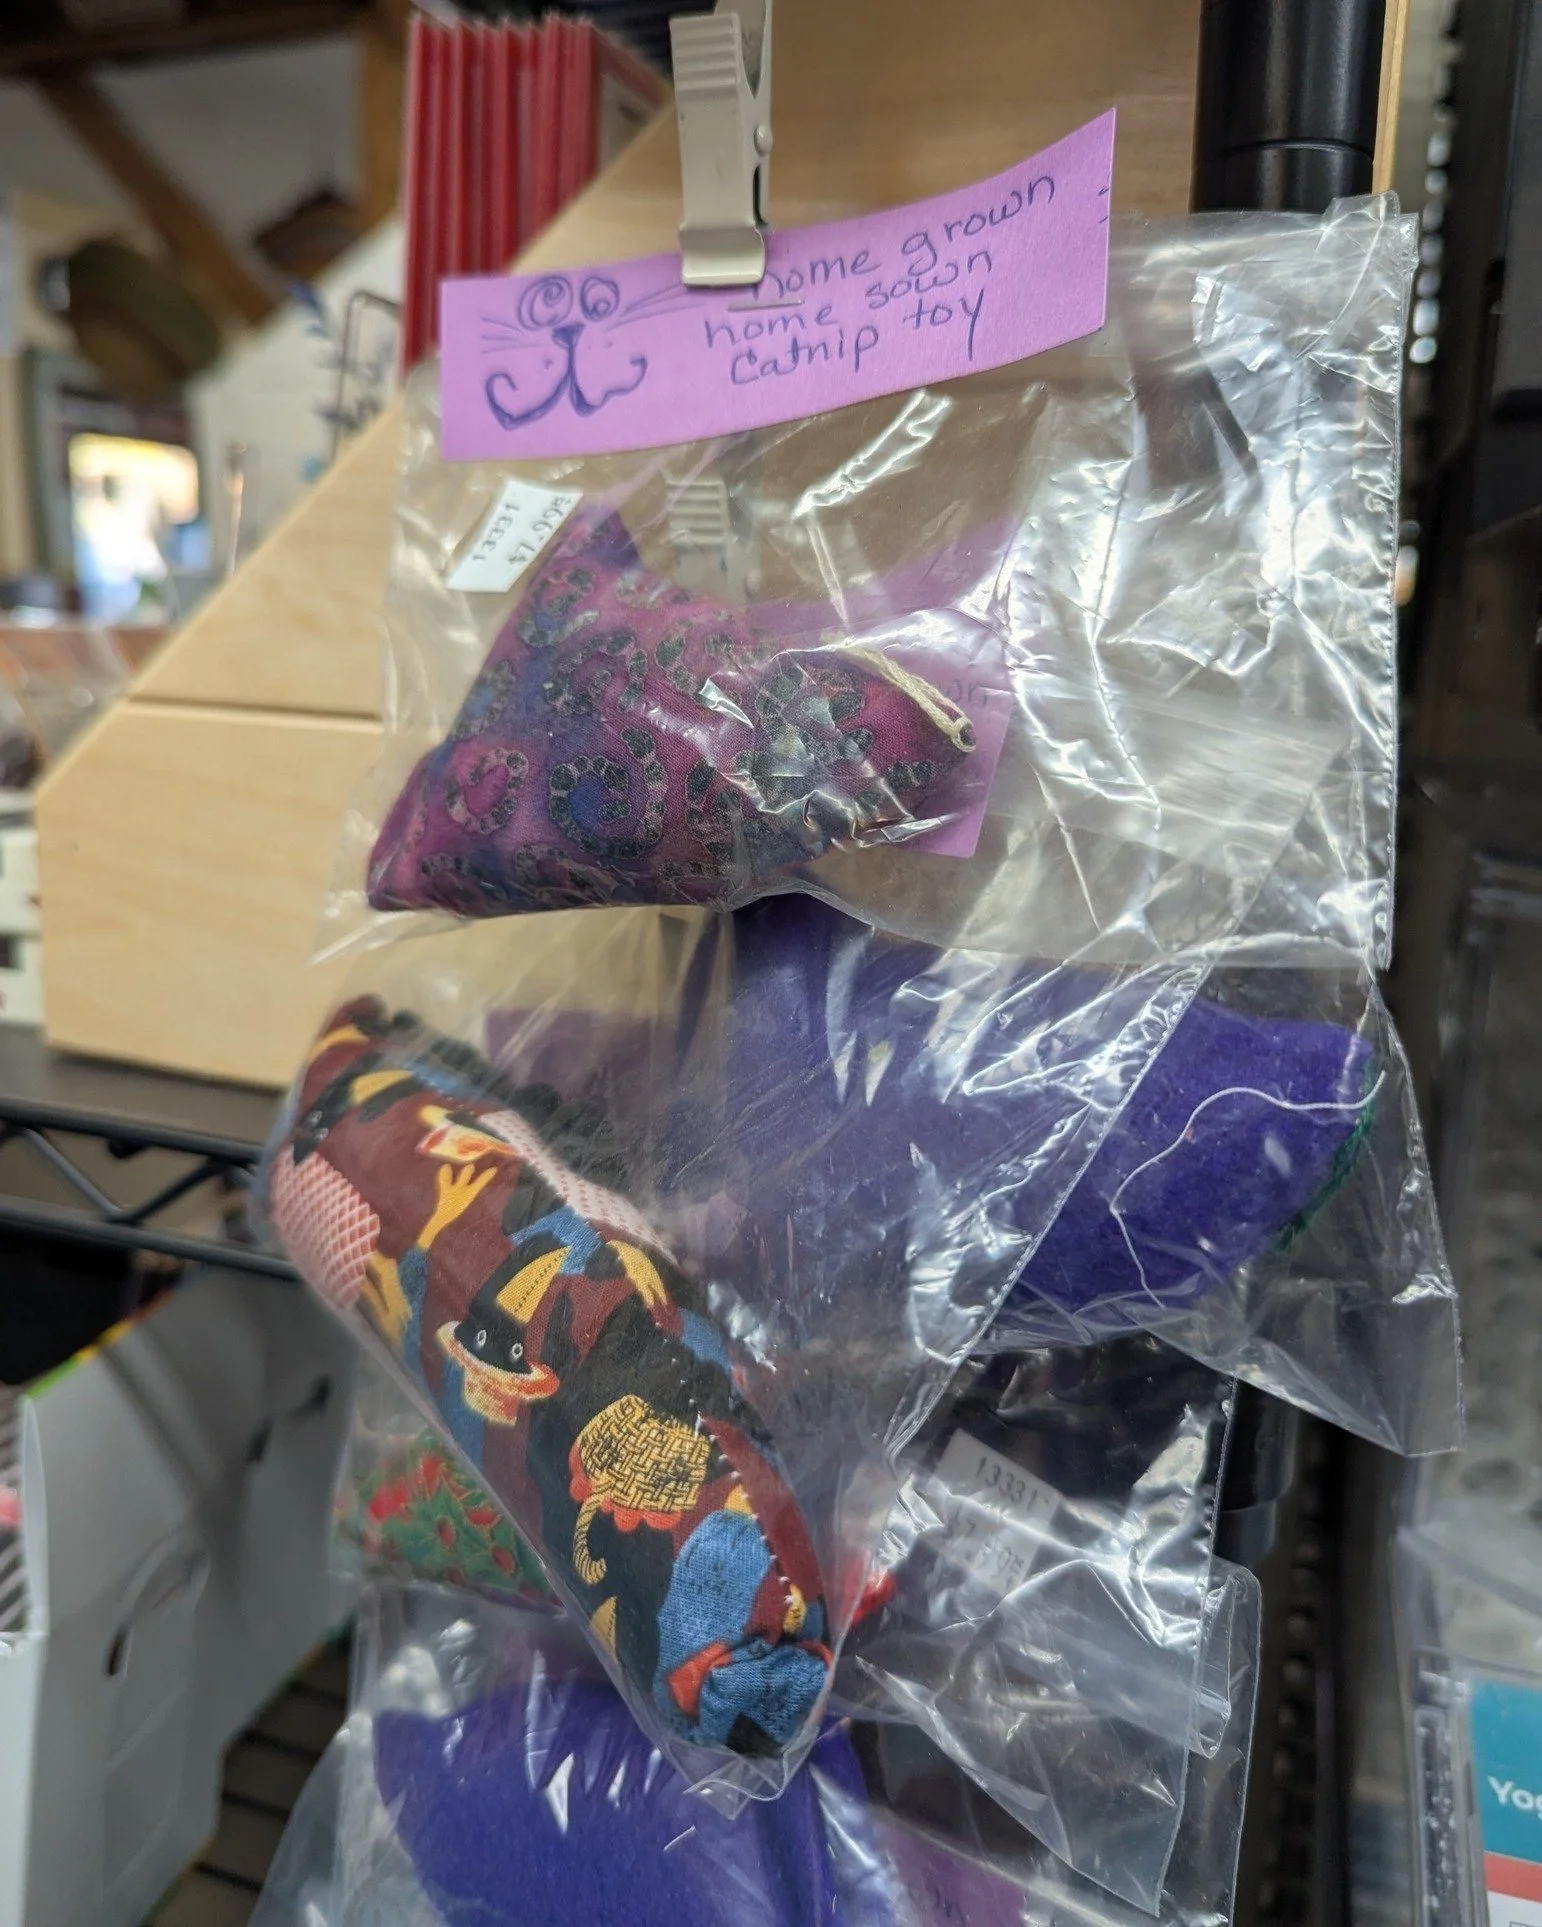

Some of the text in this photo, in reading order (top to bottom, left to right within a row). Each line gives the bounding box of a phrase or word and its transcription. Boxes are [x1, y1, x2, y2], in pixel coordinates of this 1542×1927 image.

[901, 175, 1056, 275] grown
[704, 250, 993, 349] home sown
[902, 288, 985, 362] toy
[472, 503, 520, 562] 13331
[975, 1456, 1038, 1511] 13331
